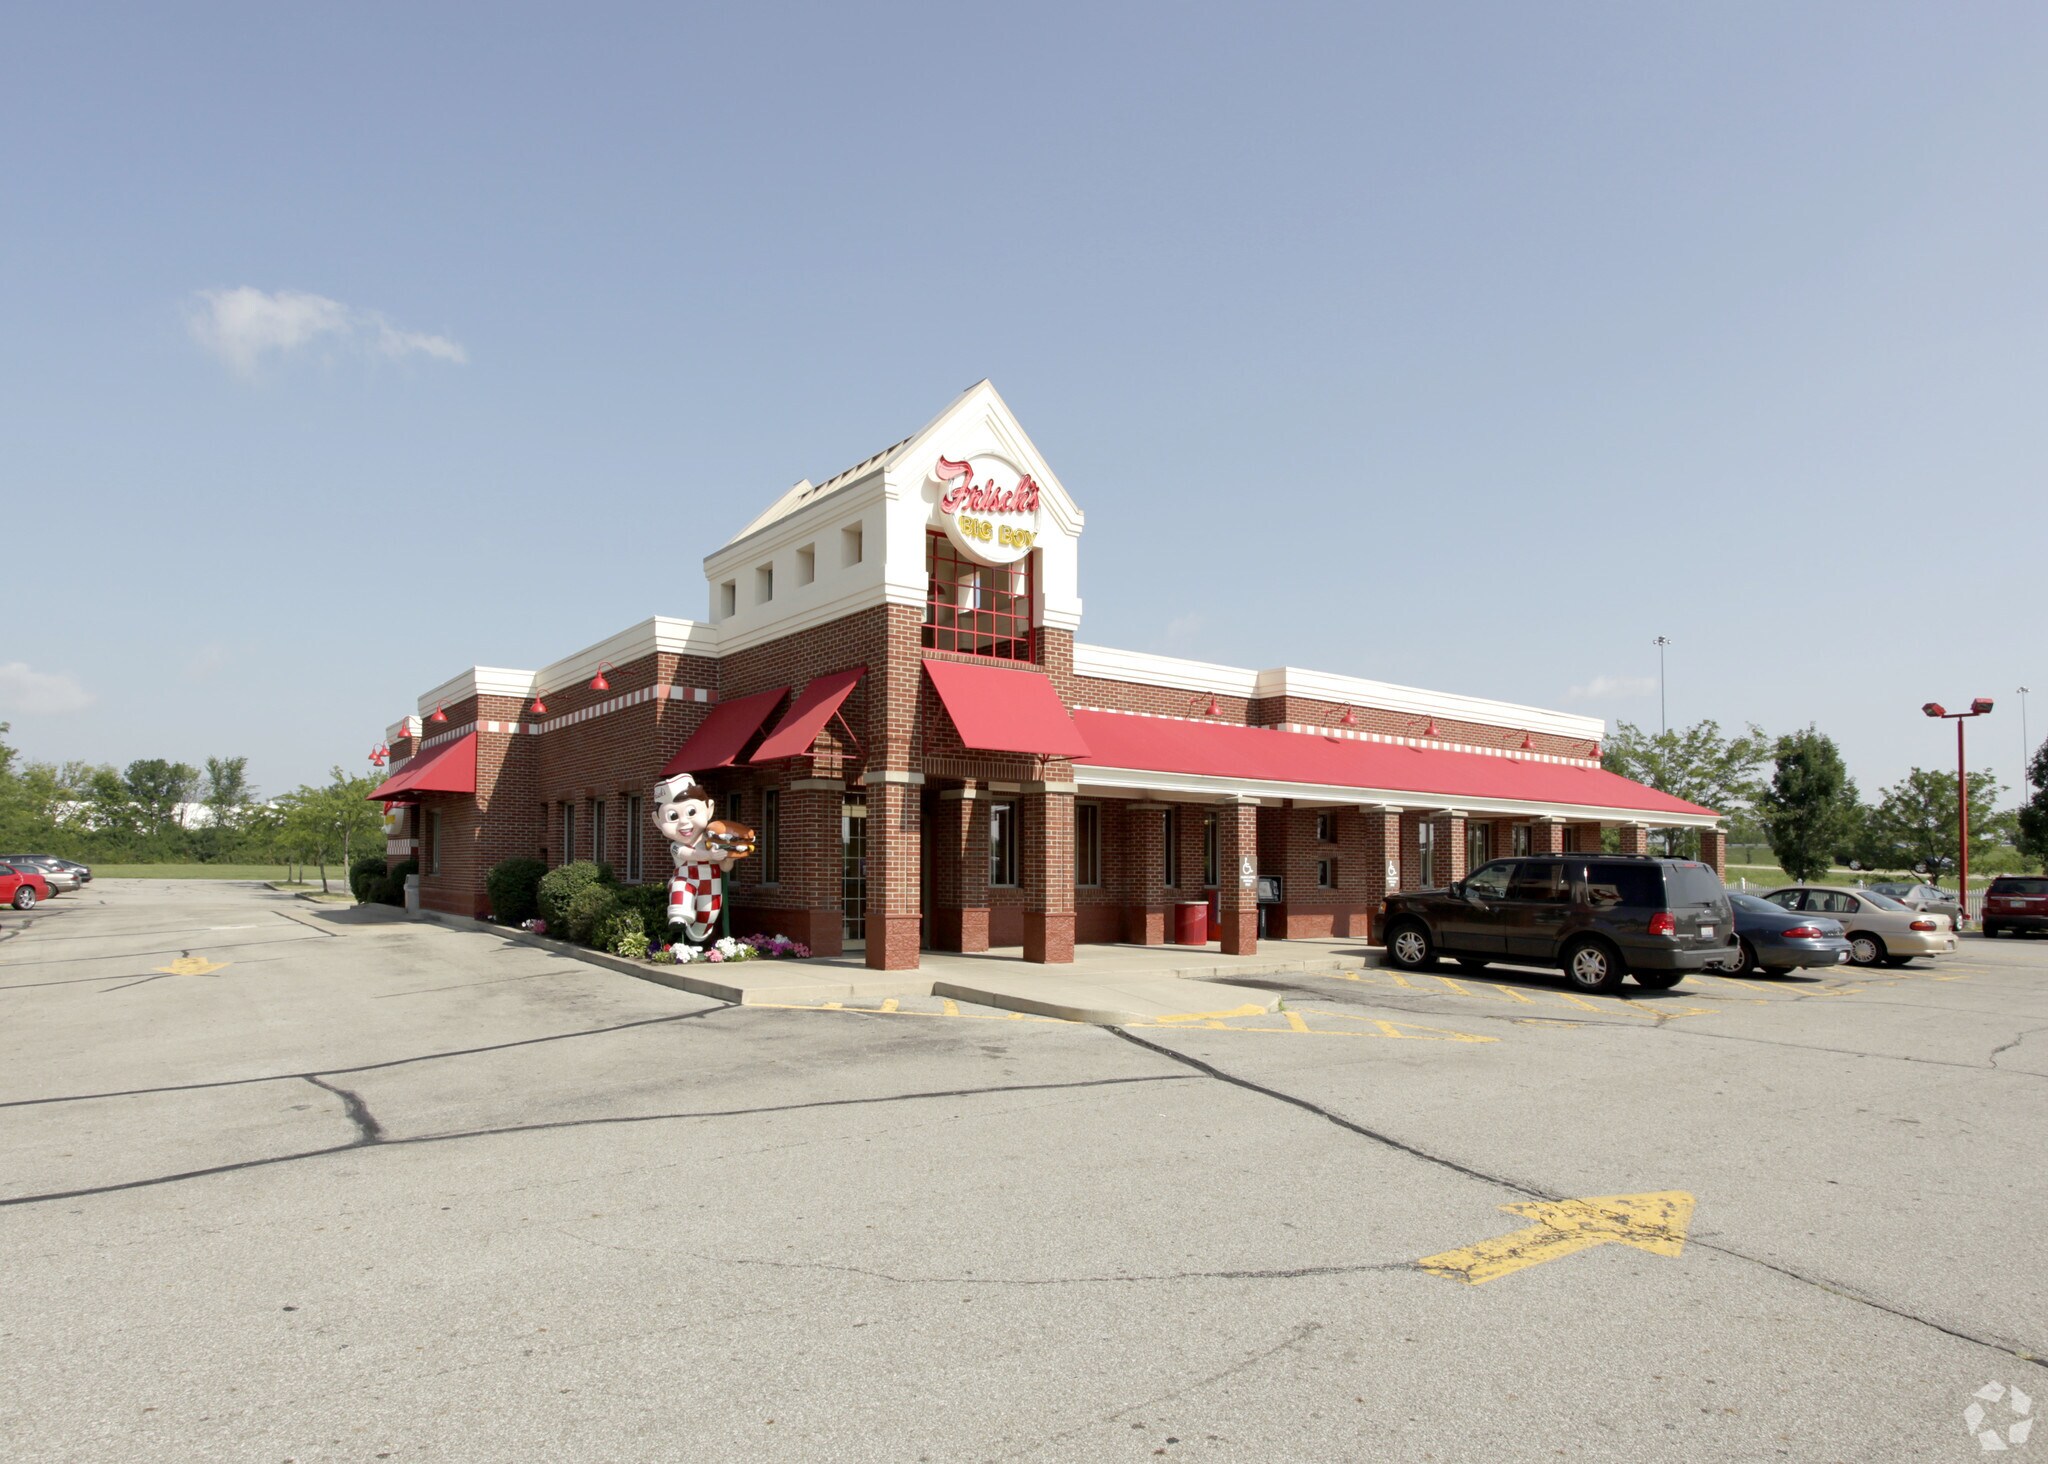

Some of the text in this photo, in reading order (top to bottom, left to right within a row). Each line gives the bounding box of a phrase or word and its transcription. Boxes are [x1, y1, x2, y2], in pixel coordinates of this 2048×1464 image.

[935, 454, 1039, 514] Frisch's
[959, 515, 1038, 548] BIG BOY
